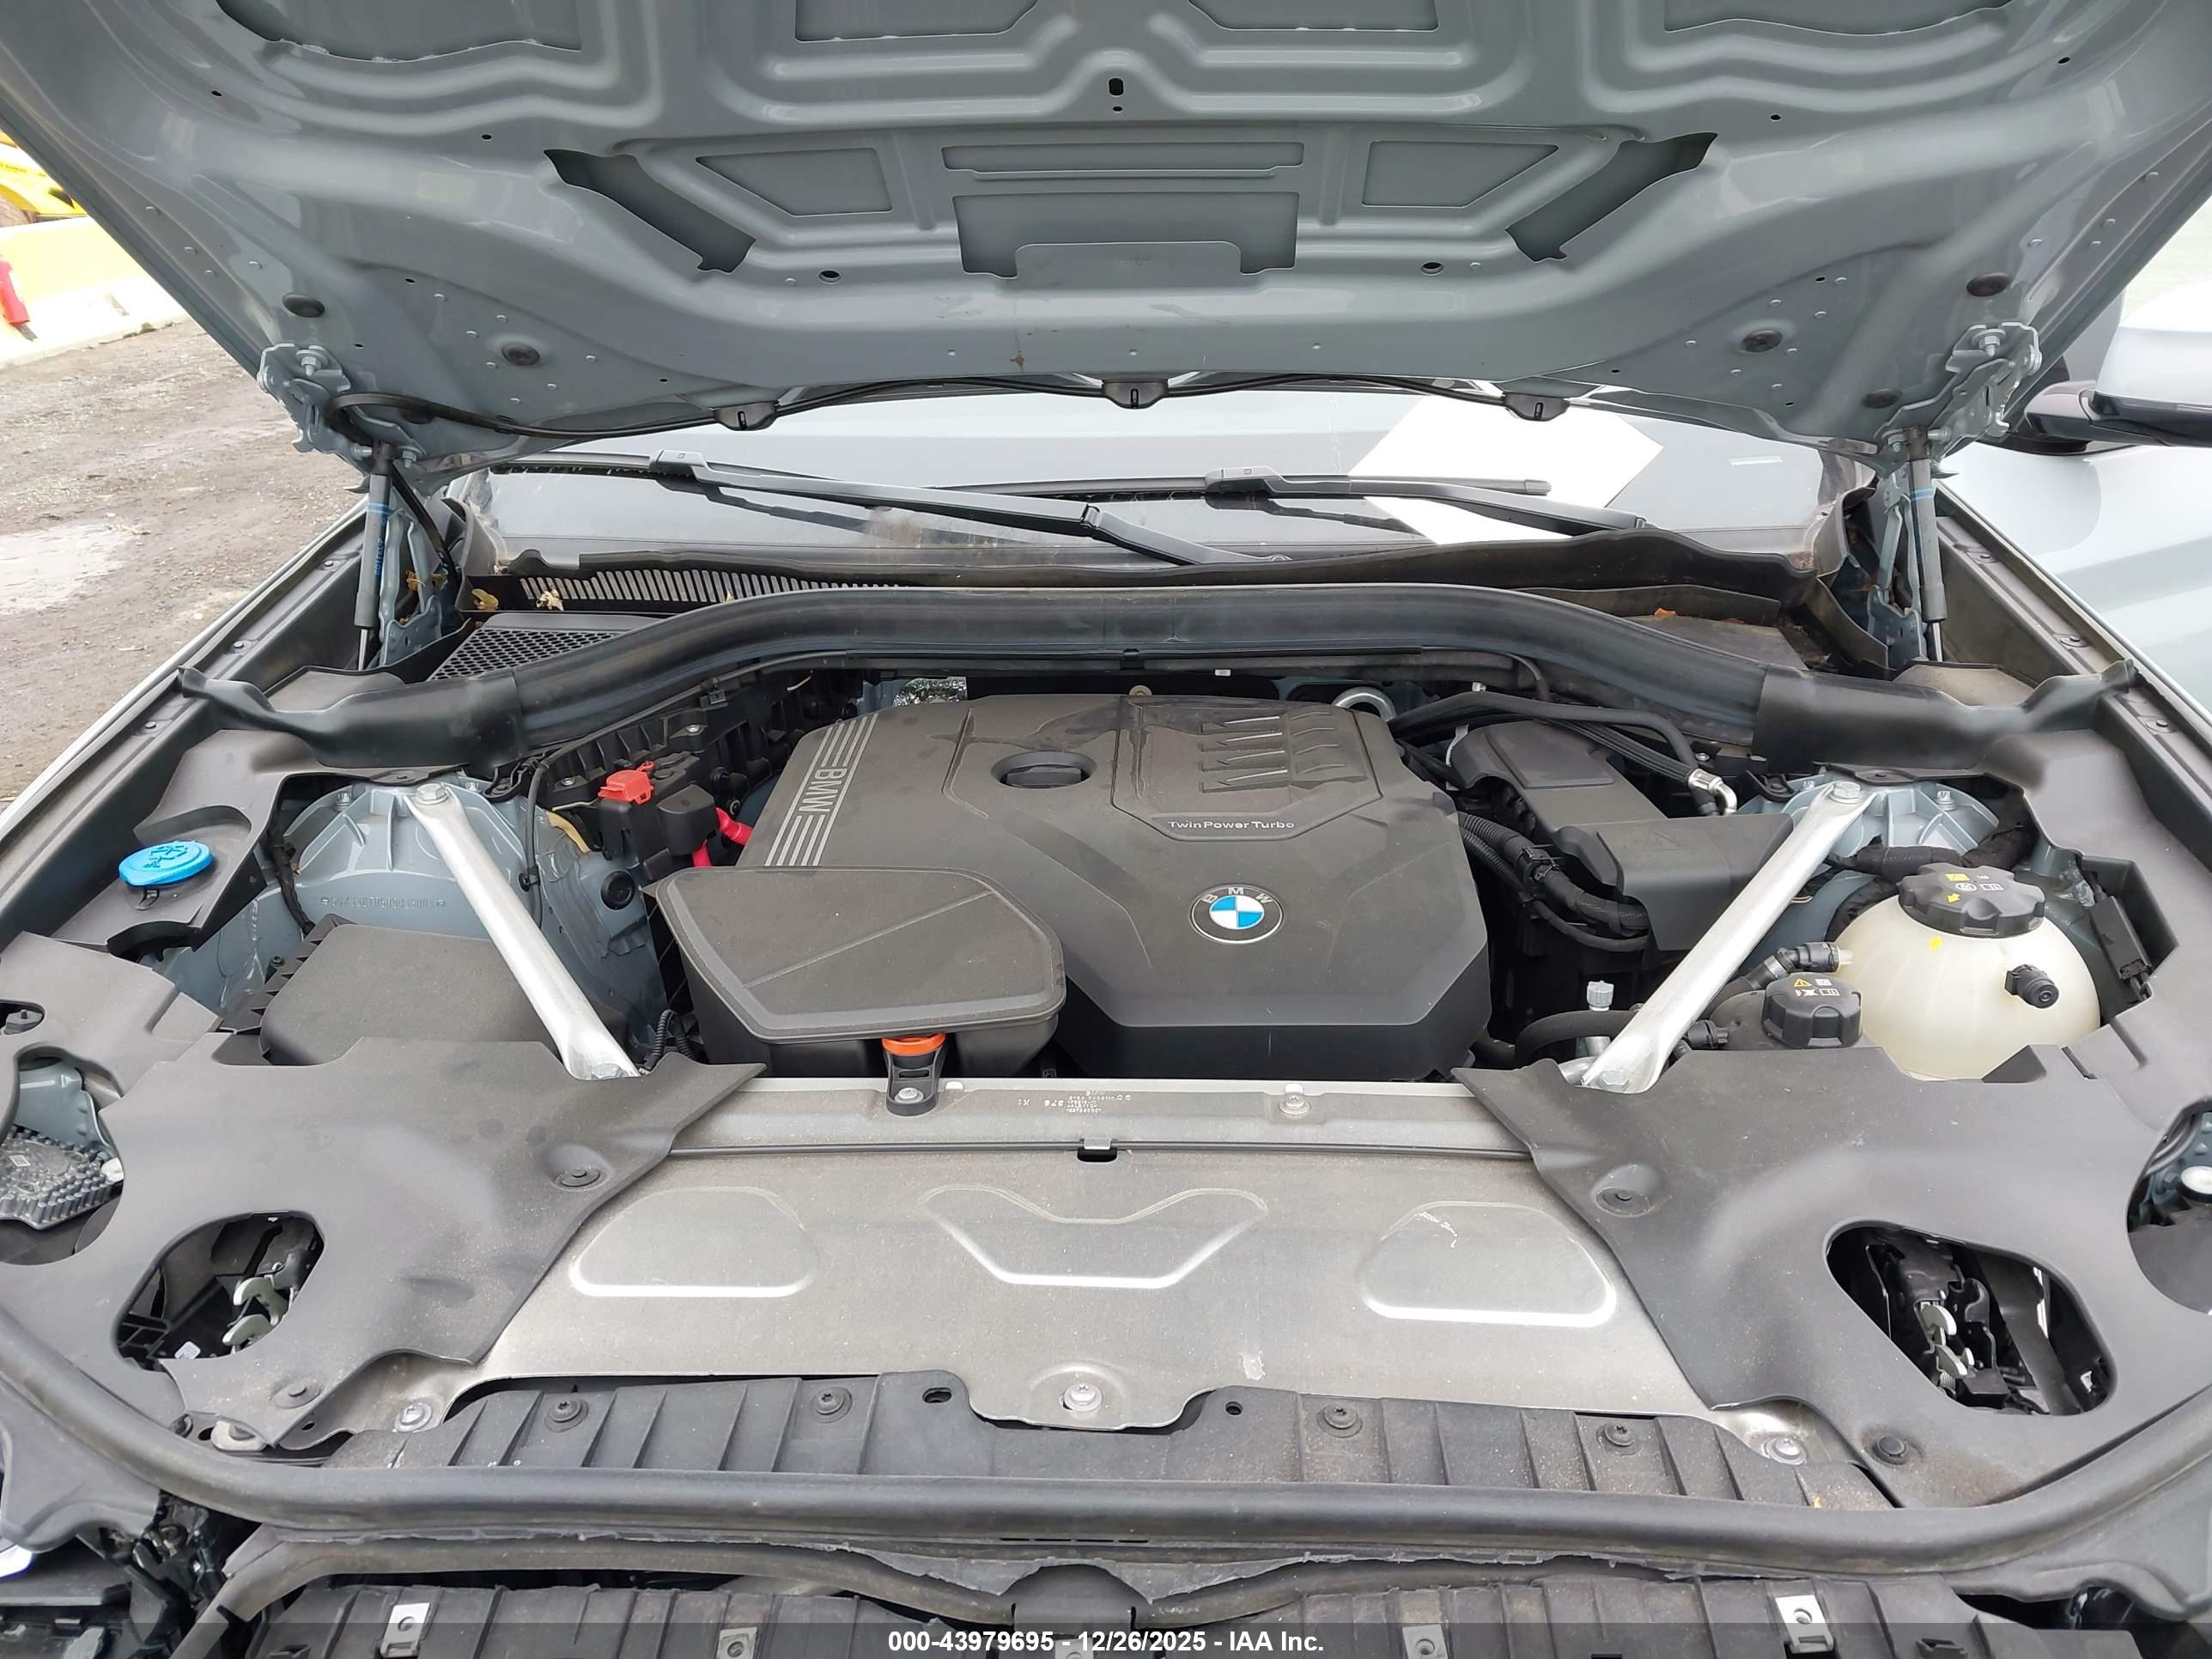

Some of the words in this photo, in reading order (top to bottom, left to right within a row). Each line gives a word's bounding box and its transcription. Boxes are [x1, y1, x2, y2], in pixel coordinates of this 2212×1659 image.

[799, 769, 848, 812] BMW
[1251, 821, 1294, 830] Turbo
[1202, 886, 1273, 904] BMW
